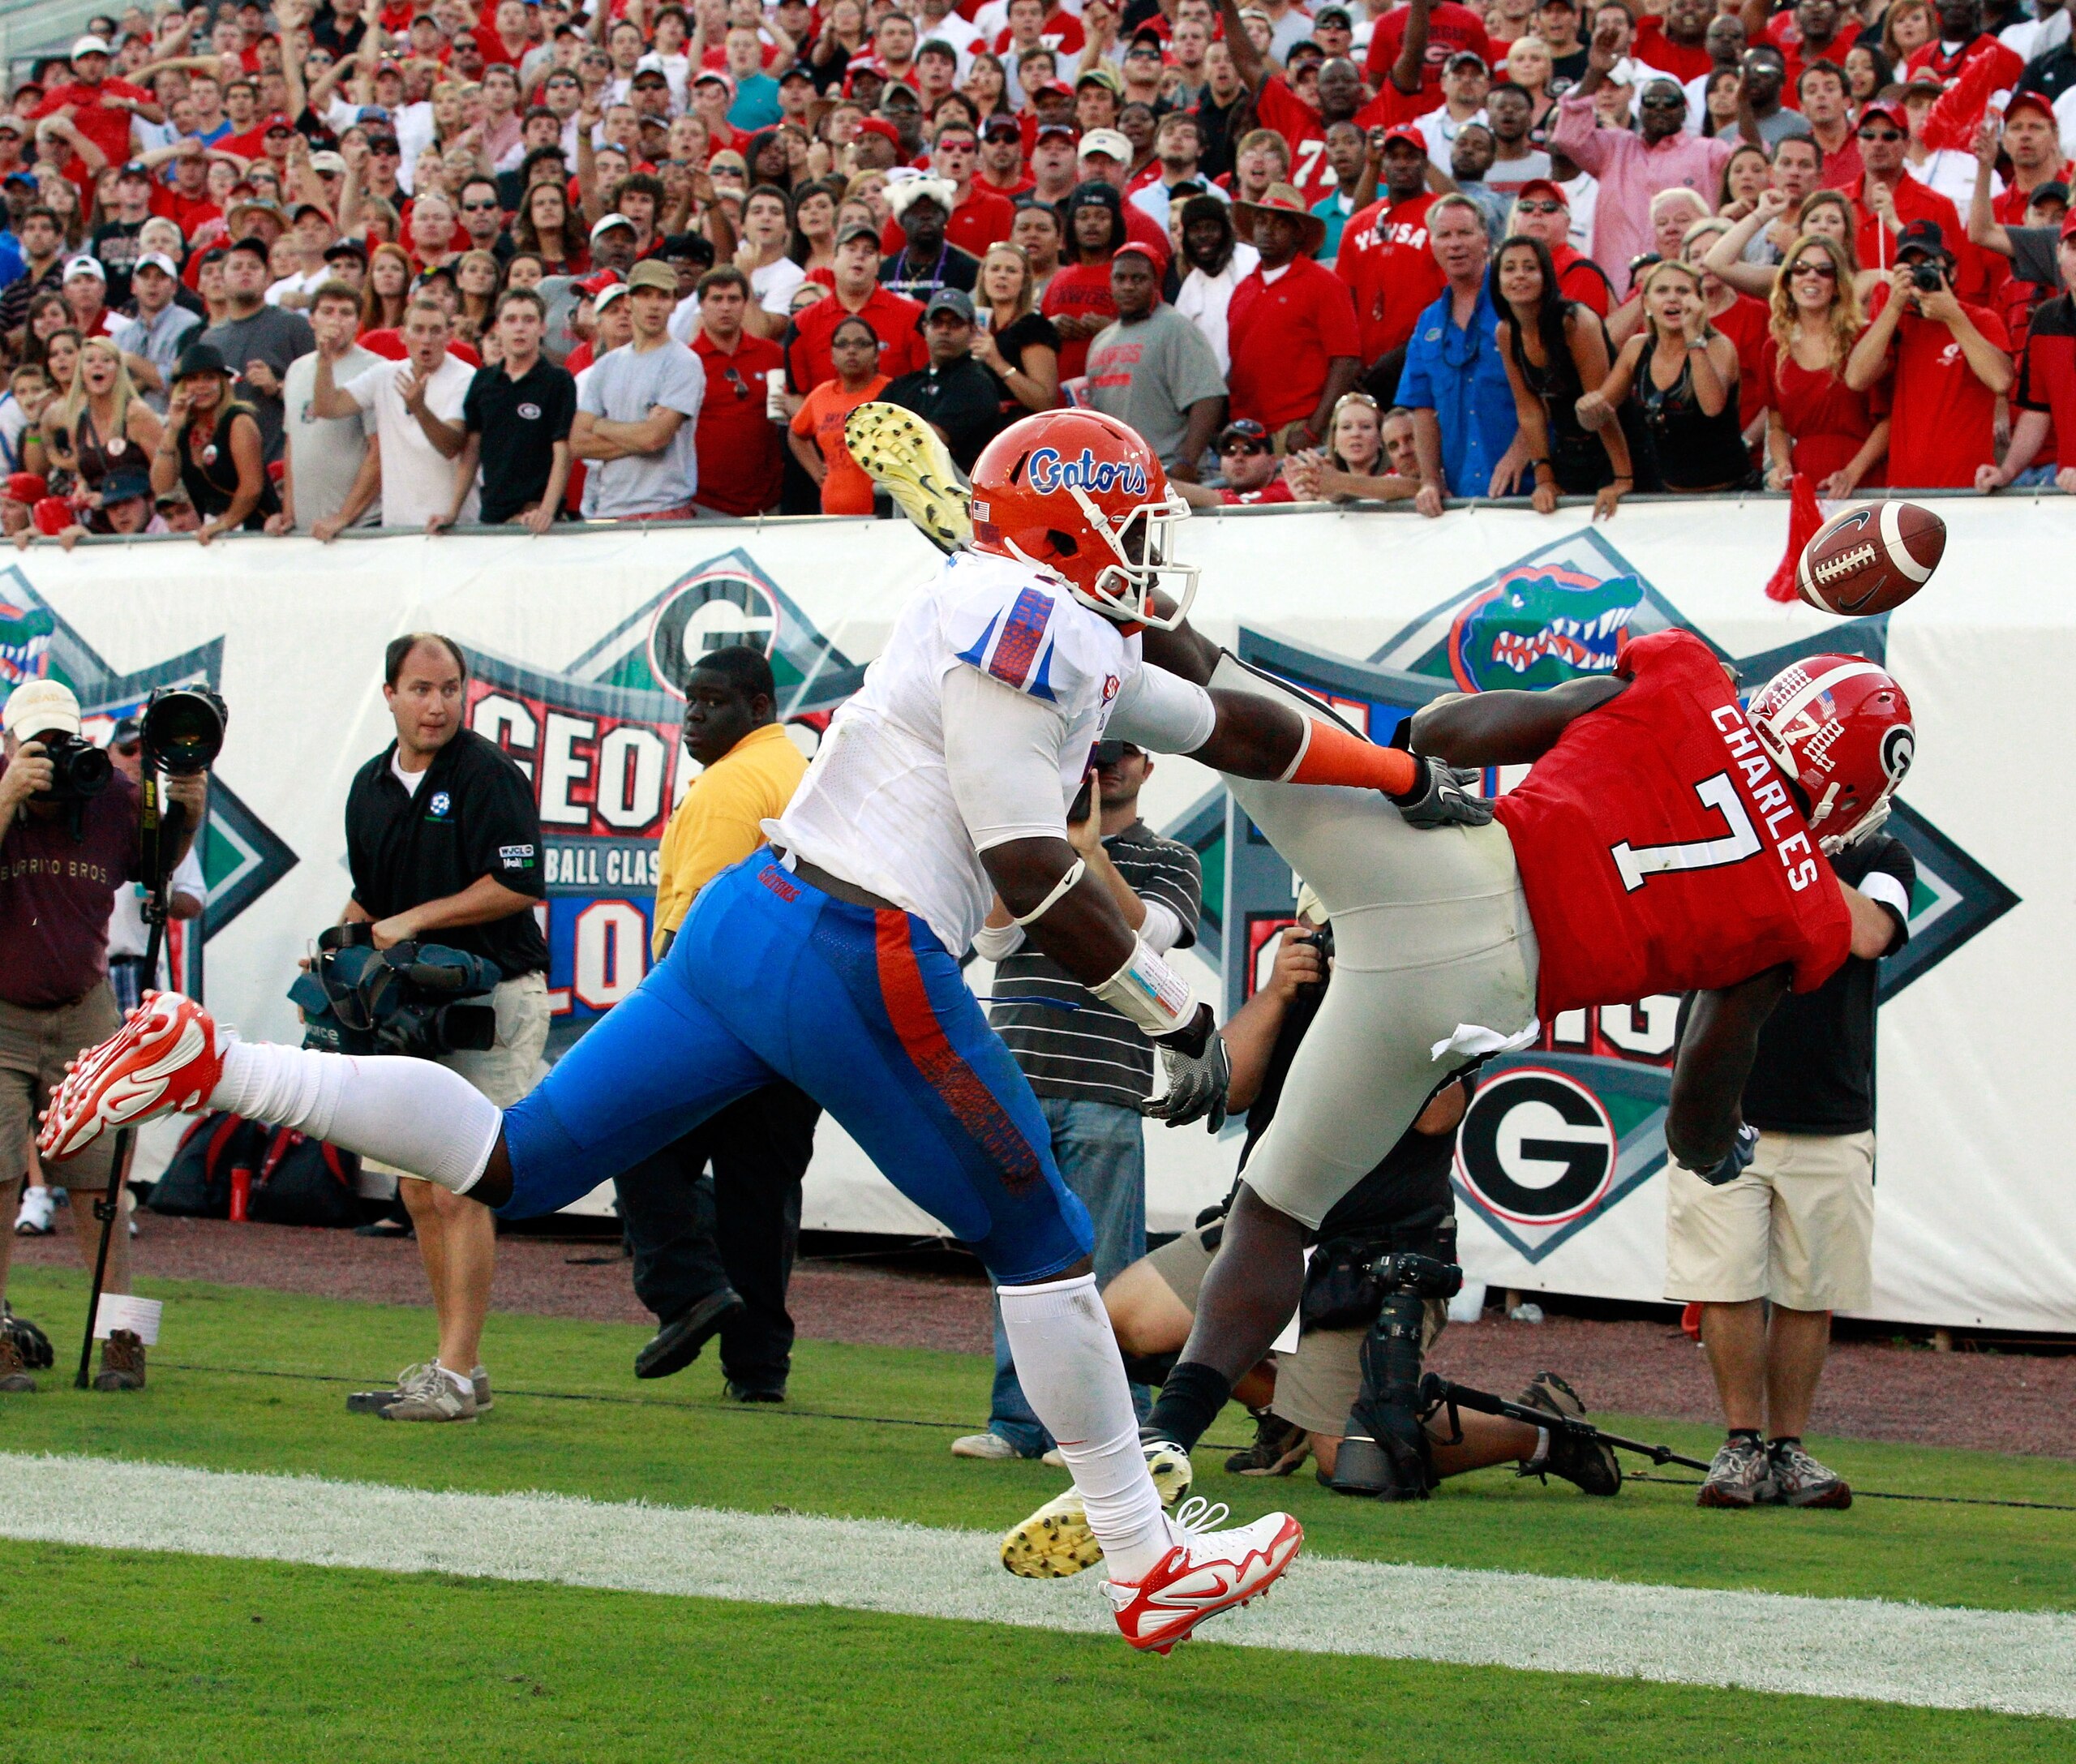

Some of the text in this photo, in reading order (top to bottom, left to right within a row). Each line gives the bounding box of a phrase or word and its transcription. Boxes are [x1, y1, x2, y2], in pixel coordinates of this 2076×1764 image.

[1027, 447, 1147, 496] Gators
[1710, 704, 1818, 892] CHARLES
[1881, 724, 1915, 780] G
[1610, 769, 1765, 895] 7
[1461, 1077, 1611, 1217] G
